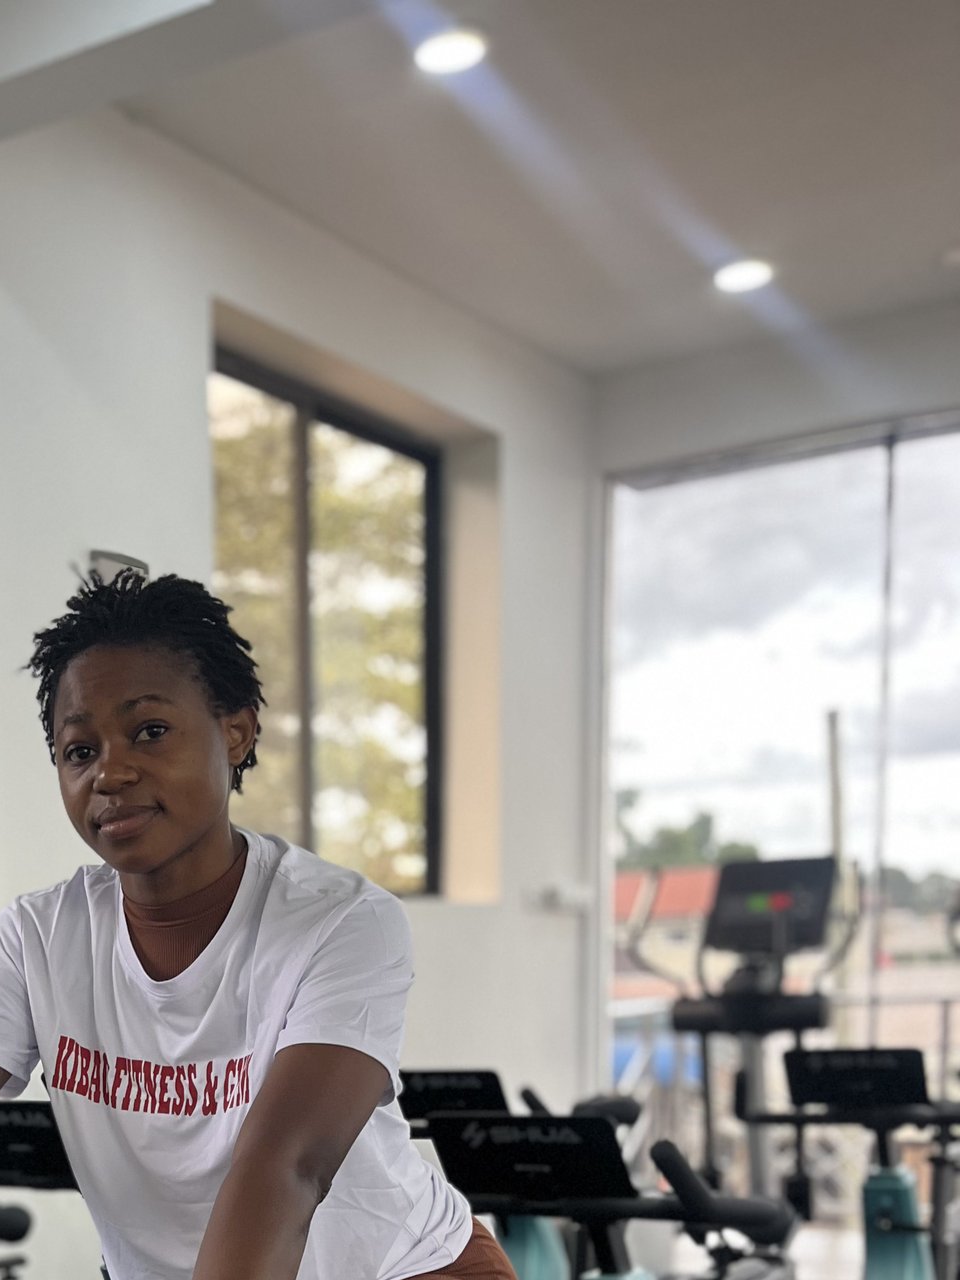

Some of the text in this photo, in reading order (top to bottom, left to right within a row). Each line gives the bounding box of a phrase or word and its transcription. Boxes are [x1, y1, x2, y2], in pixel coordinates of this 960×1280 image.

[111, 1056, 198, 1117] FITNESS
[202, 1060, 218, 1116] &
[223, 1051, 254, 1113] GM
